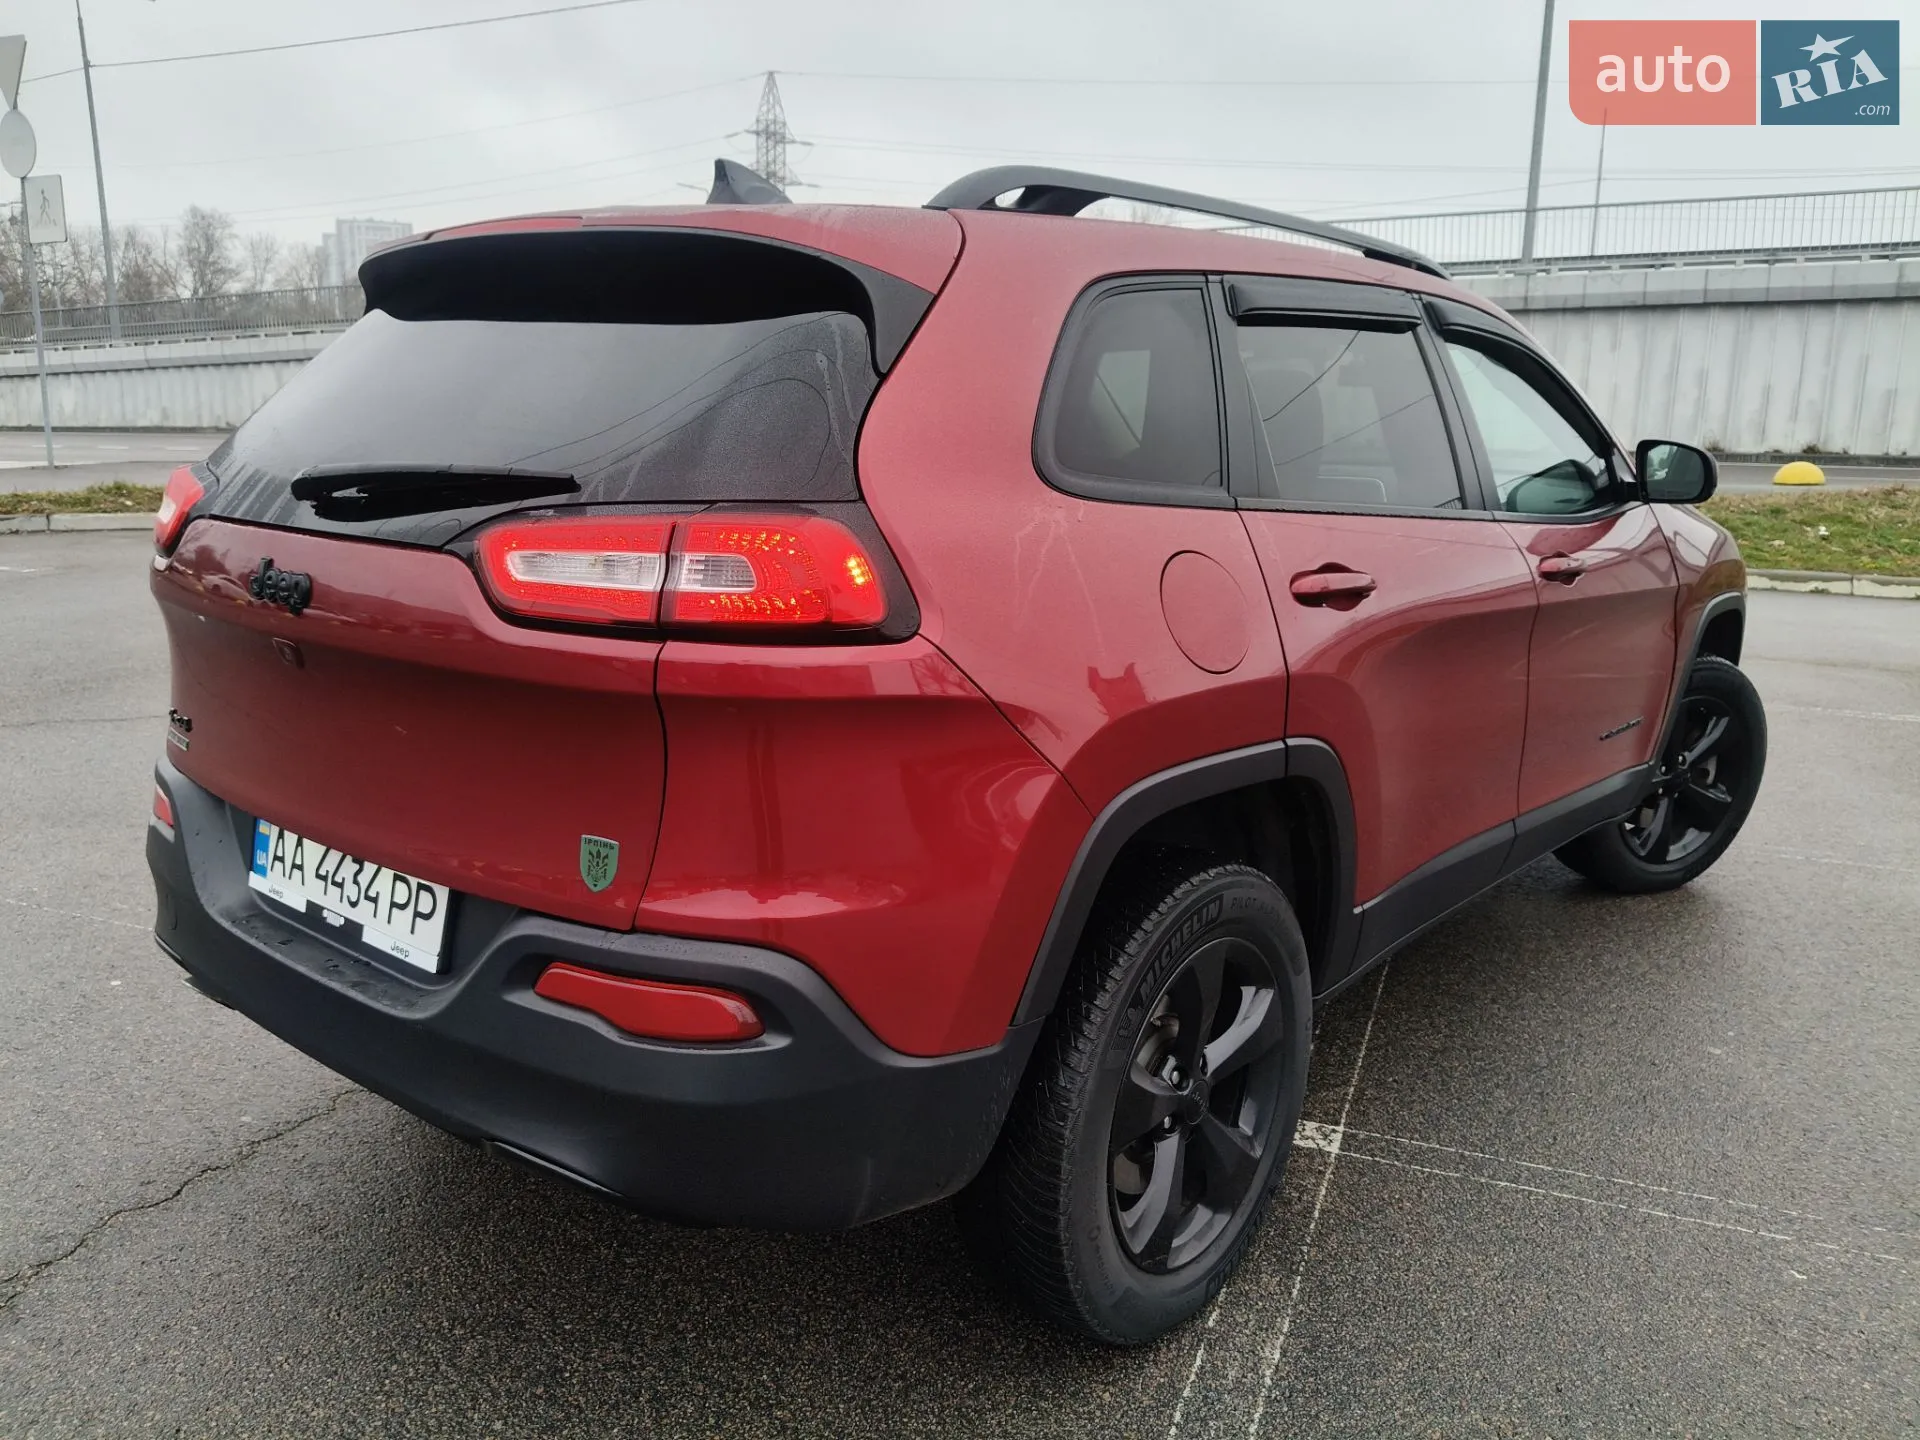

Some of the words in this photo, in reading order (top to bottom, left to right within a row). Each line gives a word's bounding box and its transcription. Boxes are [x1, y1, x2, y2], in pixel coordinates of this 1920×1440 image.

[248, 555, 312, 616] Jeep
[256, 849, 268, 868] UA
[268, 884, 284, 899] Jeep
[270, 827, 305, 886] AA
[315, 848, 381, 919] 4434
[387, 872, 437, 935] PP
[390, 941, 410, 959] Jeep
[1139, 898, 1221, 1003] MICHELIN
